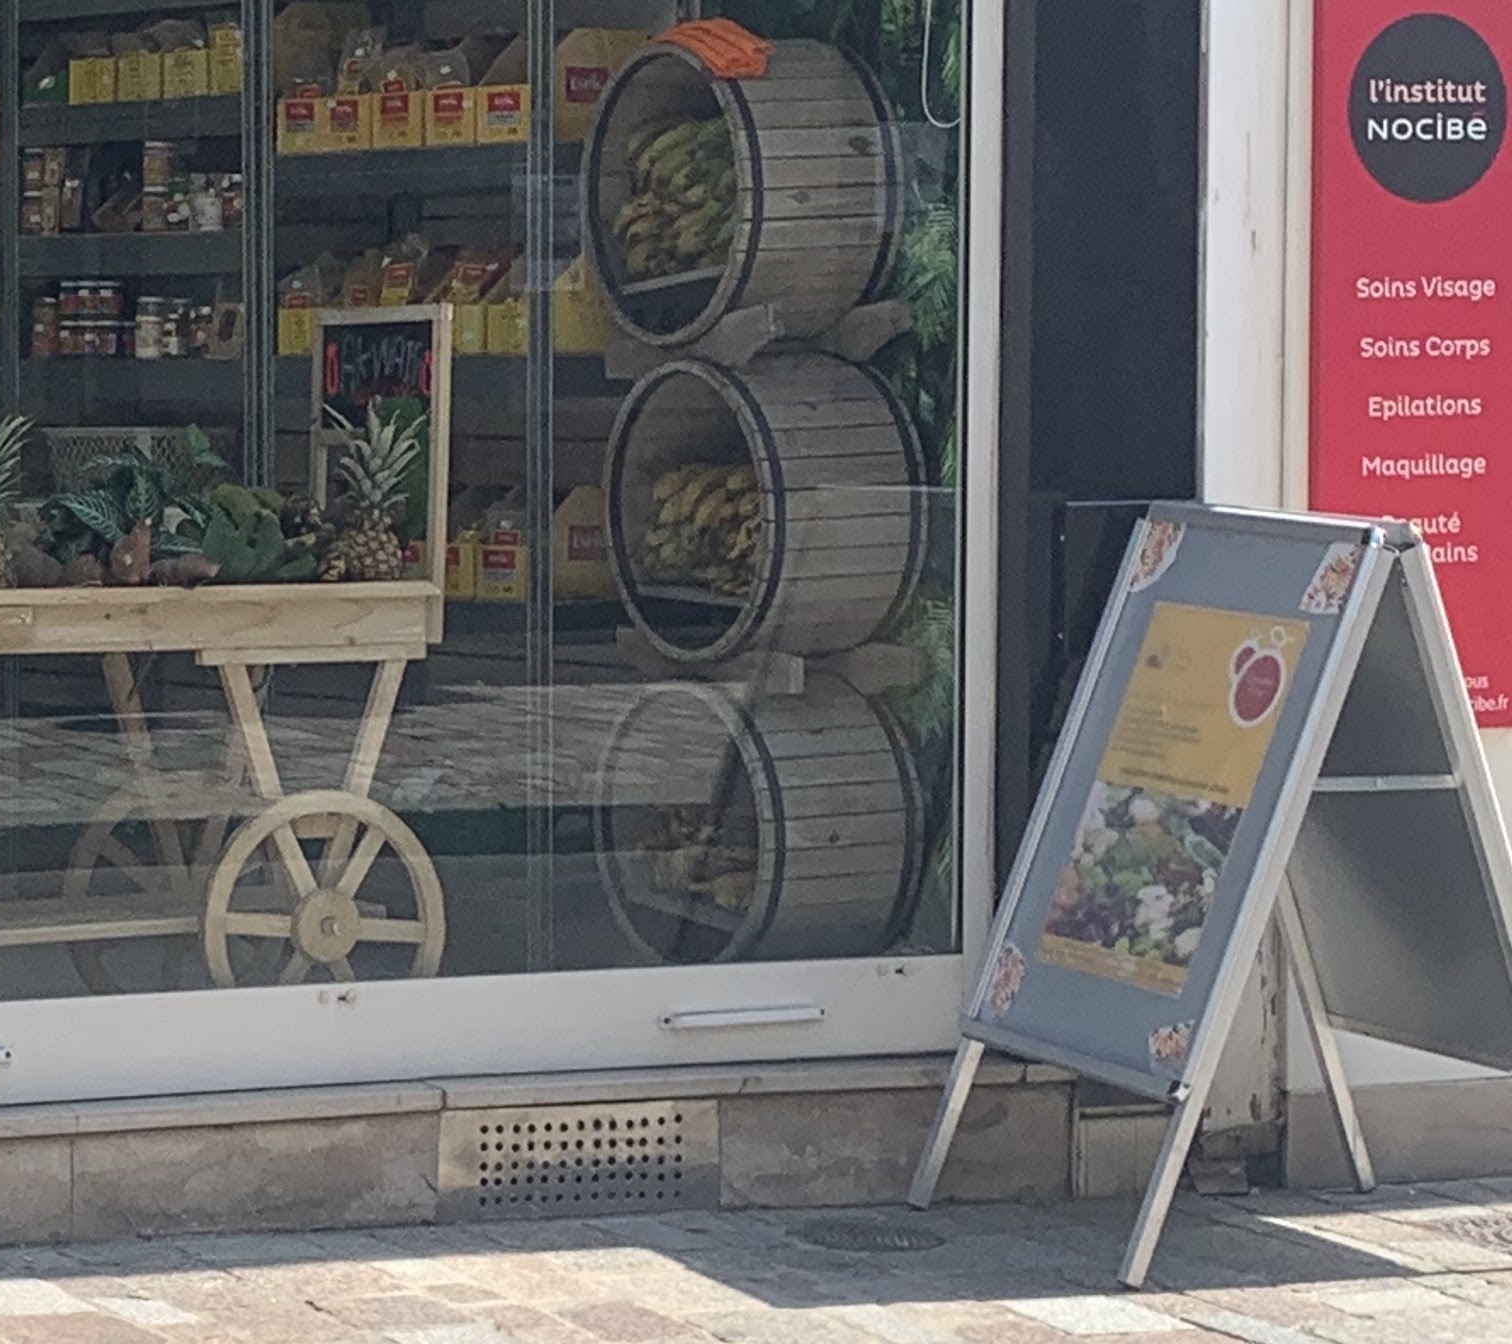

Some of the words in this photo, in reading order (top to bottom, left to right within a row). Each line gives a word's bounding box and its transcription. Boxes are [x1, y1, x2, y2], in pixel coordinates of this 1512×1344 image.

[1368, 78, 1487, 104] l'institut
[1356, 276, 1417, 299] Soins
[1421, 276, 1496, 302] Visage
[1360, 336, 1421, 358] Soins
[1425, 336, 1491, 360] Corps
[1368, 394, 1482, 421] Epilations
[1362, 453, 1487, 480] Maquillage
[1426, 541, 1479, 564] ains
